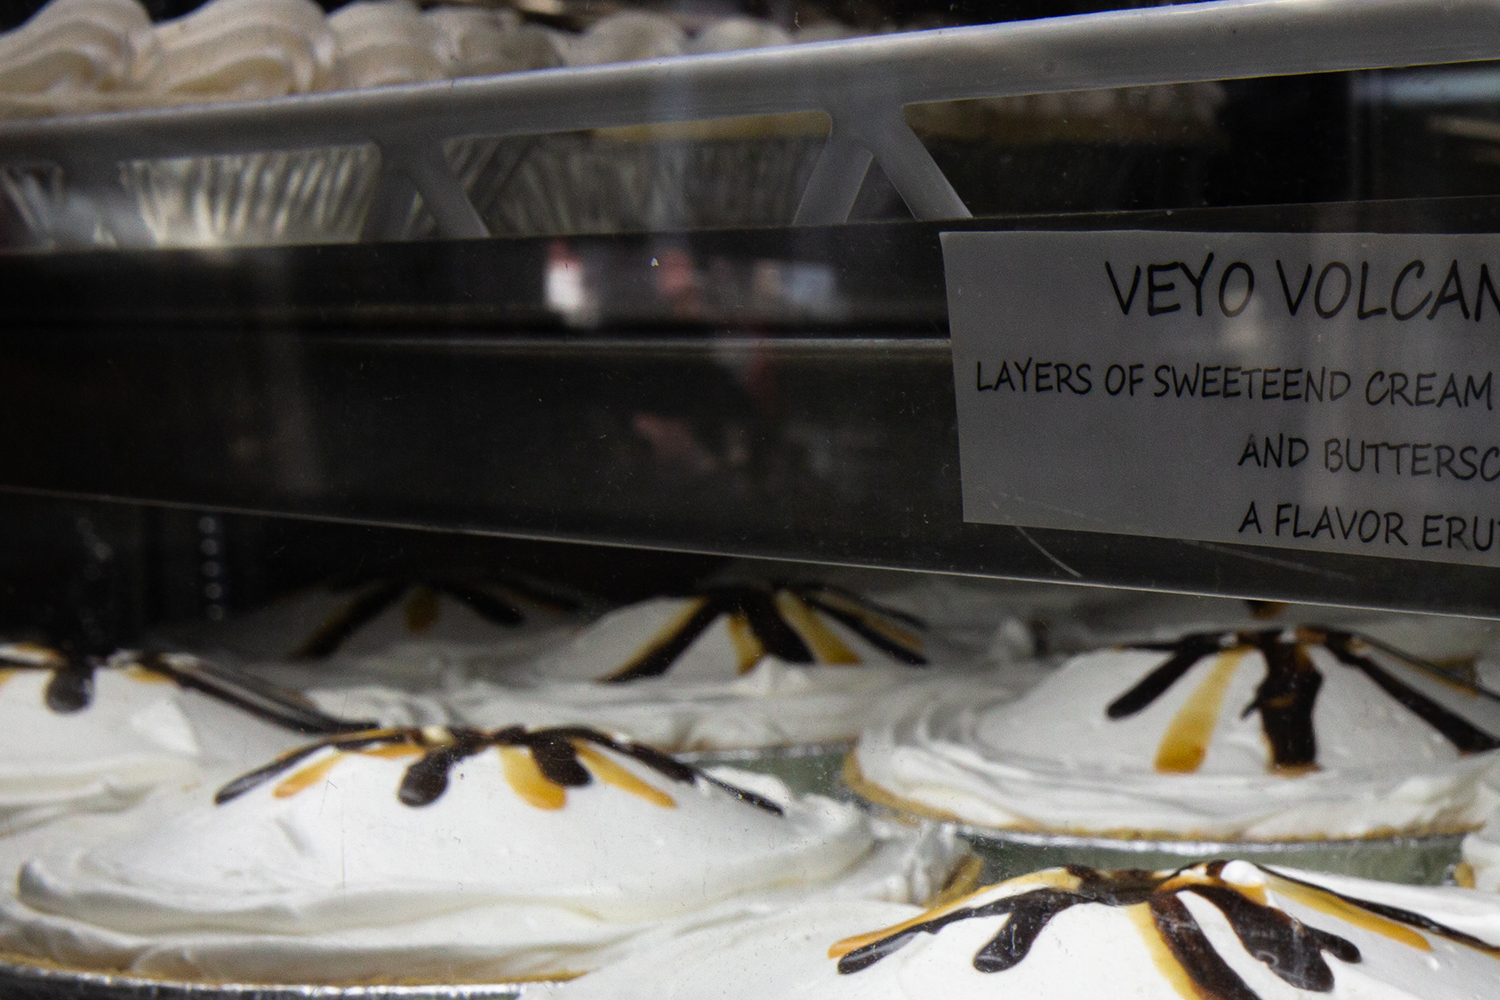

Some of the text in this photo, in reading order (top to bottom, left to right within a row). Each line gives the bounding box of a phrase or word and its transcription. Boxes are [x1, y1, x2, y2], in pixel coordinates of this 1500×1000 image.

[1105, 252, 1255, 317] VEYO
[977, 357, 1092, 395] LAYERS
[1105, 363, 1144, 396] OF
[1154, 362, 1351, 402] SWEETEEND
[1366, 371, 1492, 411] CREAM
[1238, 433, 1309, 468] AND
[1238, 501, 1262, 534] A
[1276, 503, 1408, 546] FLAVOR
